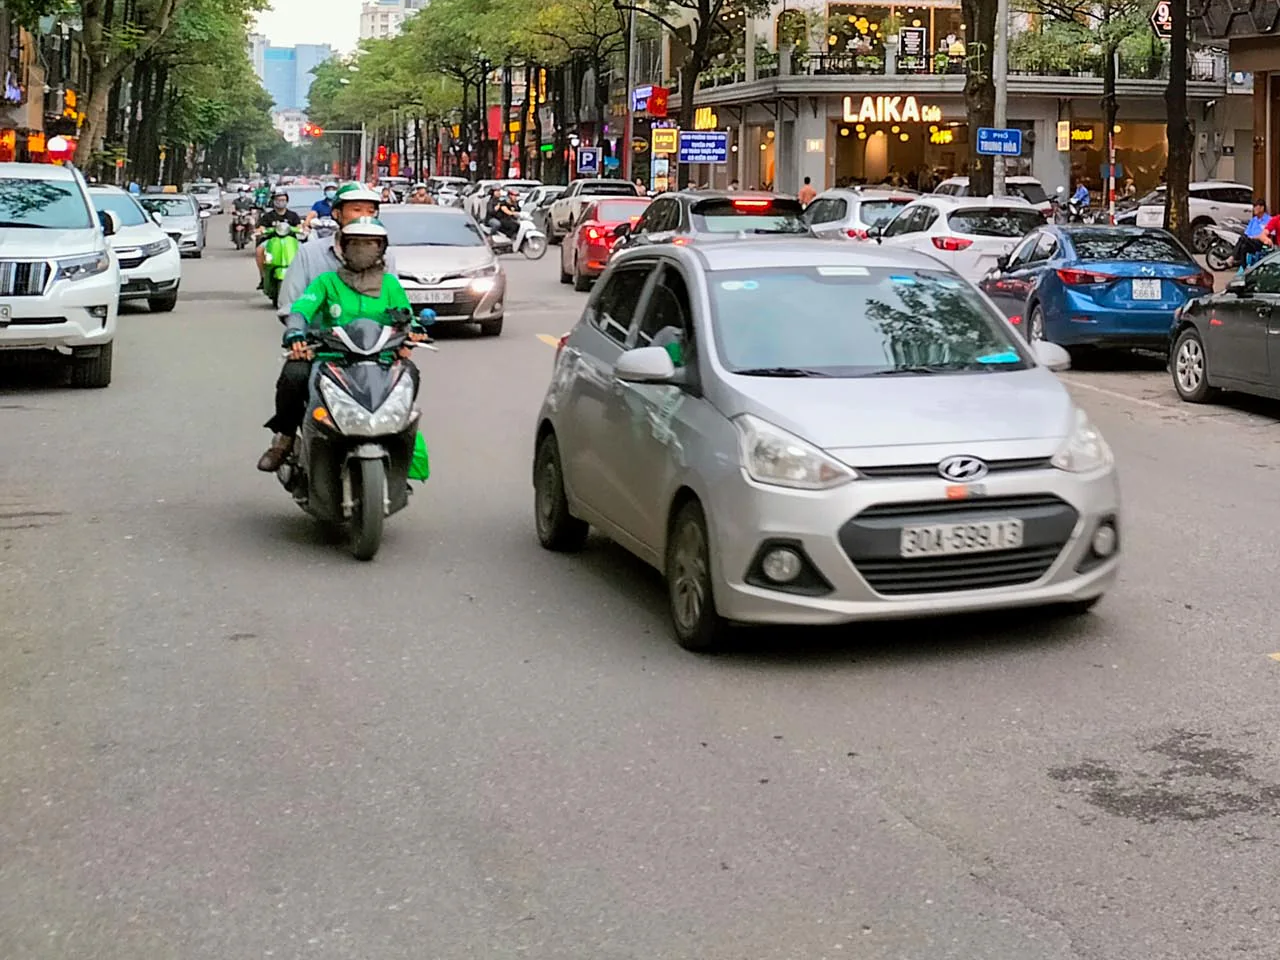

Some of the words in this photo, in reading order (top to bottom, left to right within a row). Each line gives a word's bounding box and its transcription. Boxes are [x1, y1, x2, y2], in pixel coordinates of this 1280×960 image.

[843, 96, 921, 123] LAIKA
[980, 141, 1002, 152] TRUNG
[582, 152, 594, 166] P
